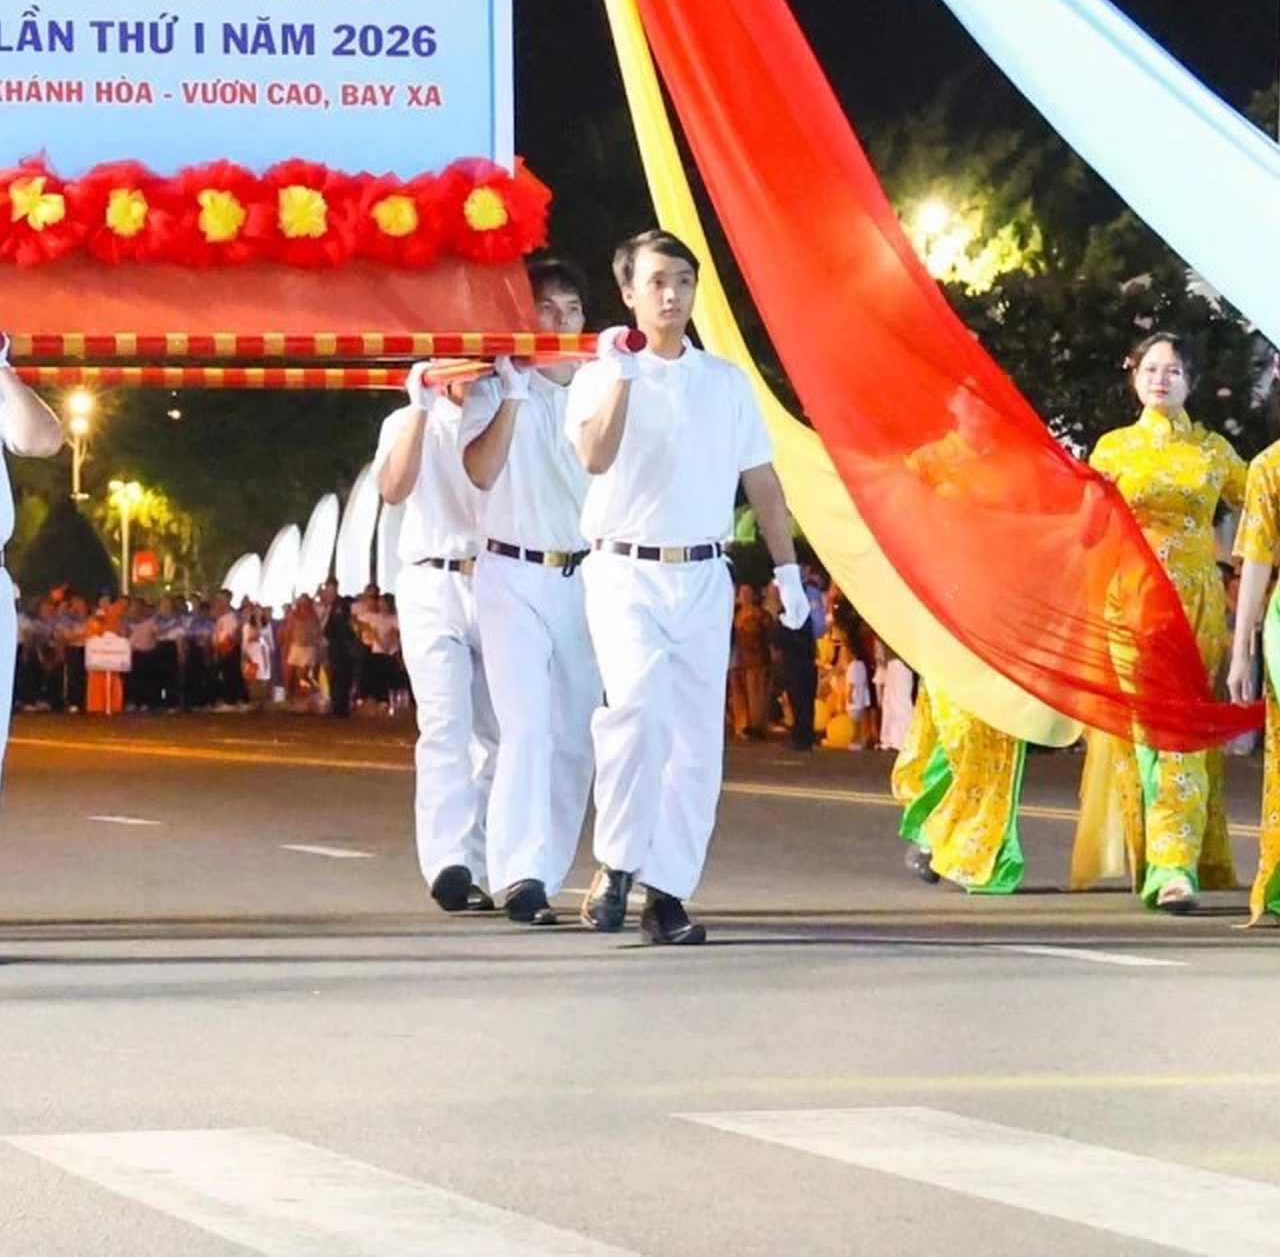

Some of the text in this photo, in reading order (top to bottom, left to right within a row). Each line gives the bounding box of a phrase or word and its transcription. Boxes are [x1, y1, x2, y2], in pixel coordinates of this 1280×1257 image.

[89, 12, 180, 55] THỨ
[194, 22, 205, 55] I
[222, 16, 316, 56] NĂM
[332, 23, 437, 58] 2026
[95, 75, 153, 104] HÒA
[182, 78, 257, 105] VƯƠN
[267, 82, 330, 109] CAO,
[341, 84, 395, 106] BAY
[407, 85, 442, 107] XA
